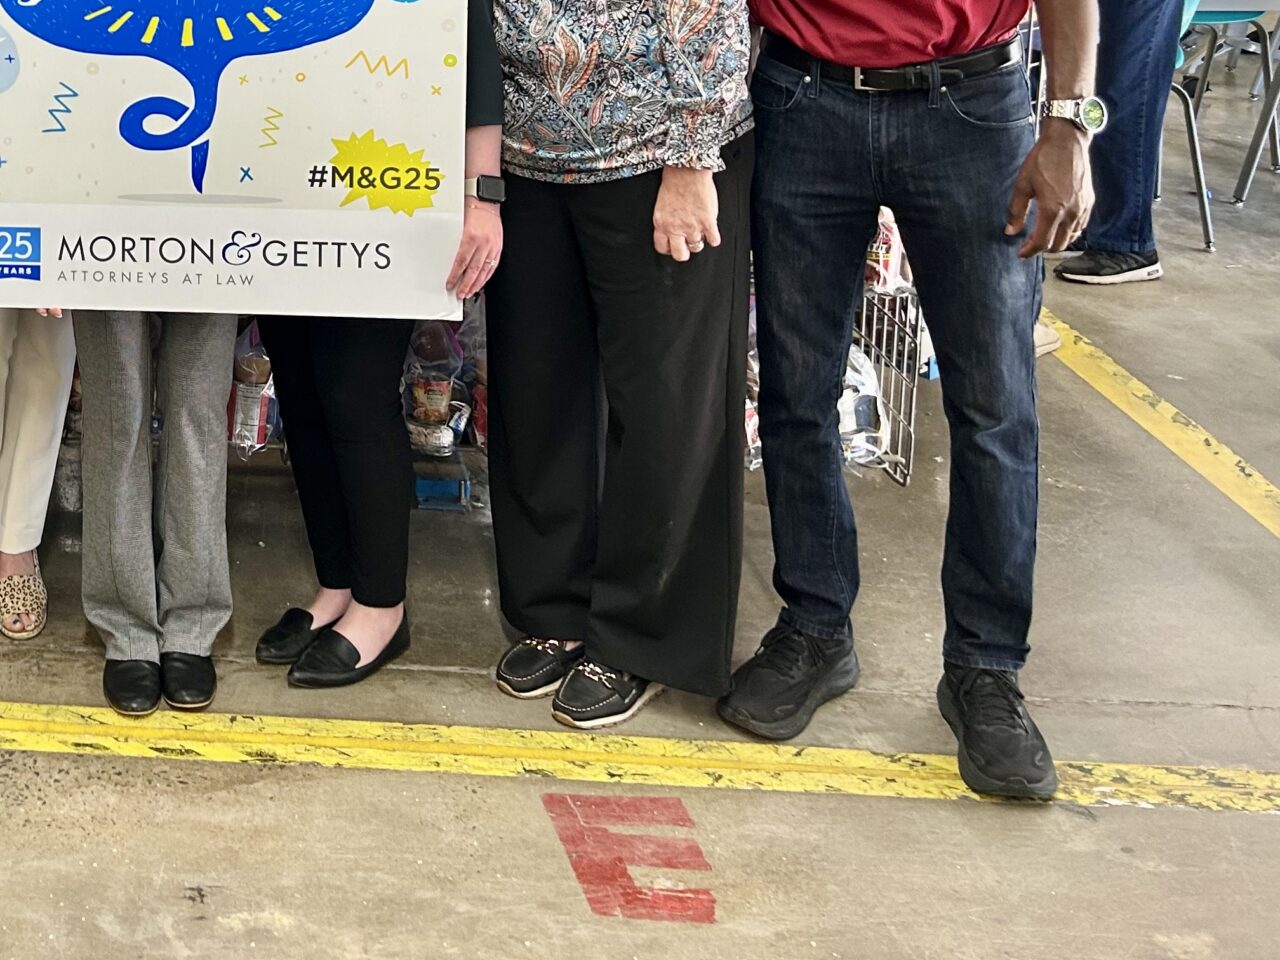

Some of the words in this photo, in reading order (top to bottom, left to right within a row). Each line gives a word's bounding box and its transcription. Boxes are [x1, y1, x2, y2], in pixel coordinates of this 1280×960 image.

[308, 165, 442, 191] #M&G25
[57, 270, 169, 285] ATTORNEYS
[182, 273, 203, 285] AT
[216, 274, 255, 286] LAW
